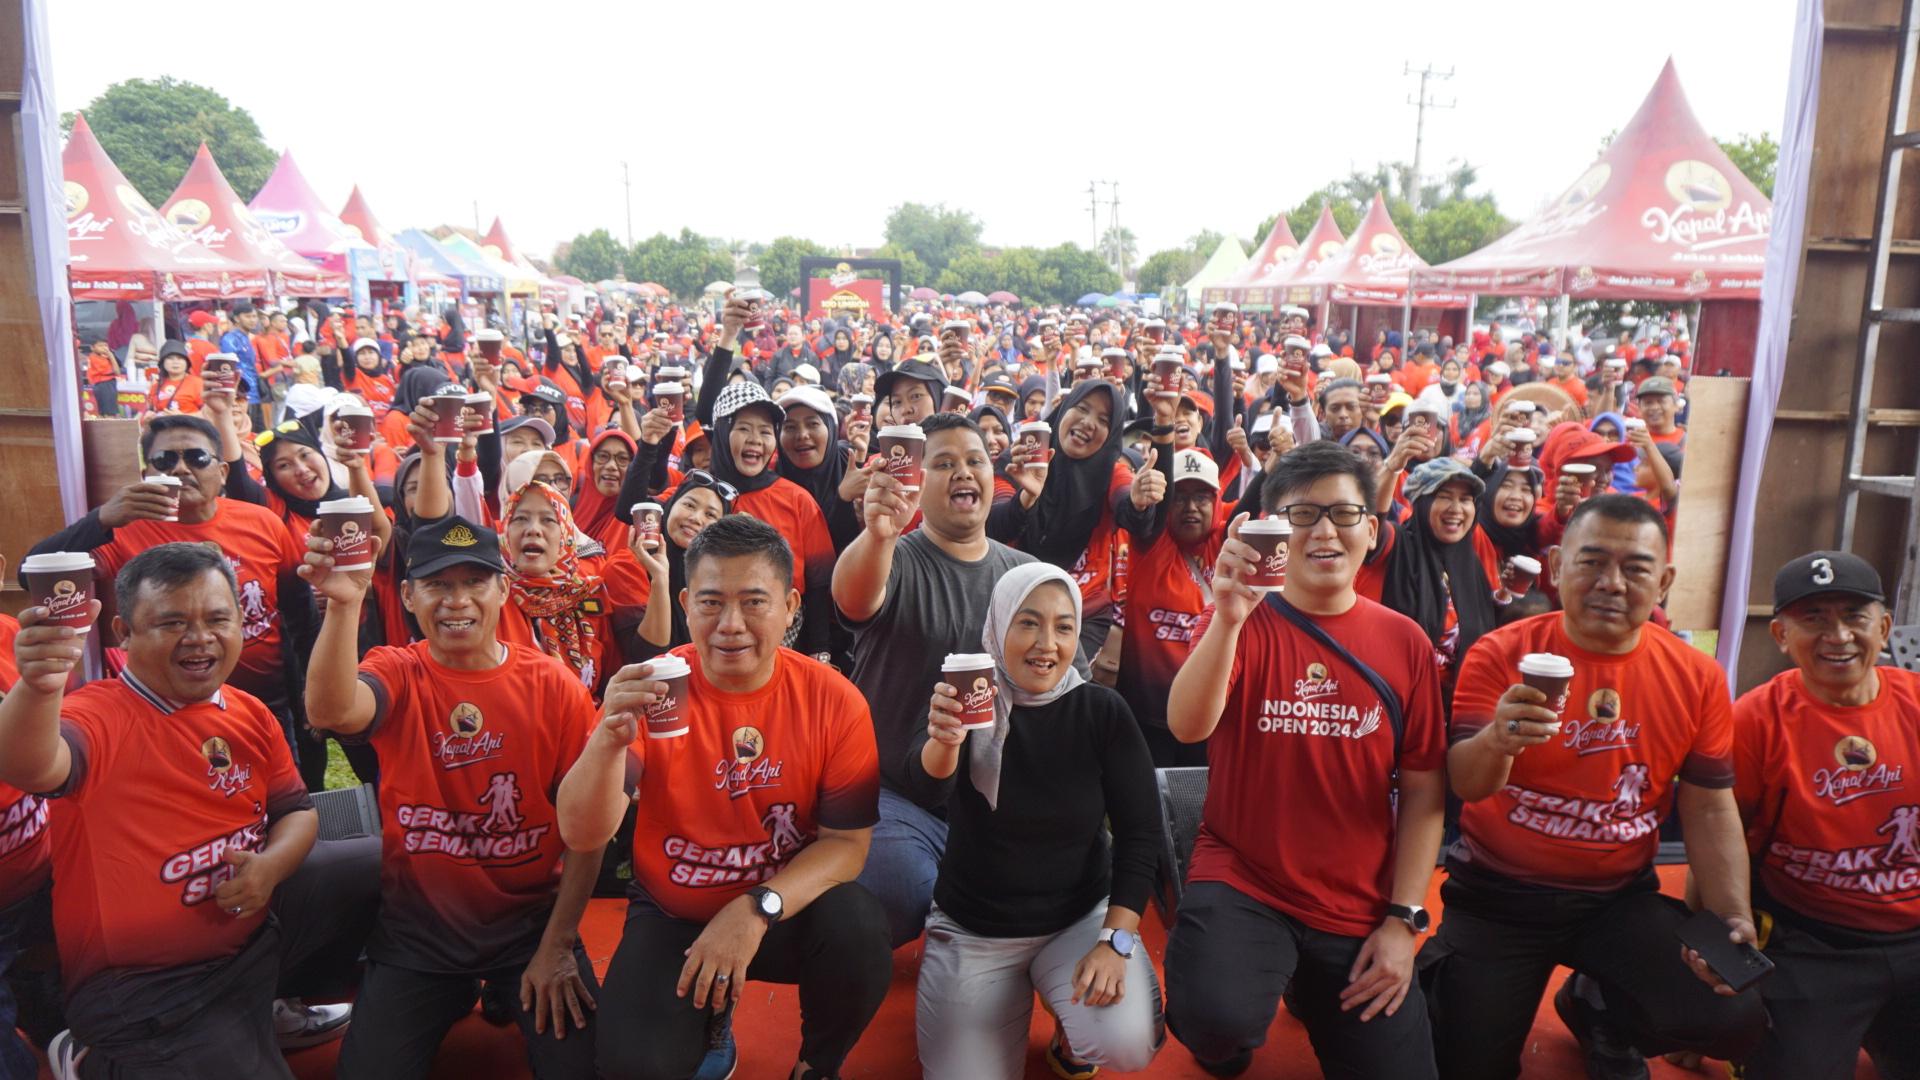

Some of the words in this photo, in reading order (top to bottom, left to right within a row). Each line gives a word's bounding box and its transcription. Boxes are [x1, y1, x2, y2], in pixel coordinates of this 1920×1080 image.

[1641, 203, 1726, 242] Kapal
[1811, 558, 1834, 585] 3
[1257, 716, 1308, 735] OPEN
[1310, 720, 1351, 737] 2024
[1563, 719, 1609, 749] Kapal
[1610, 719, 1640, 743] Api
[433, 731, 471, 763] Kapal
[472, 731, 504, 756] Api
[750, 757, 782, 784] Api
[1813, 766, 1866, 799] Kapal
[1866, 763, 1902, 787] Api
